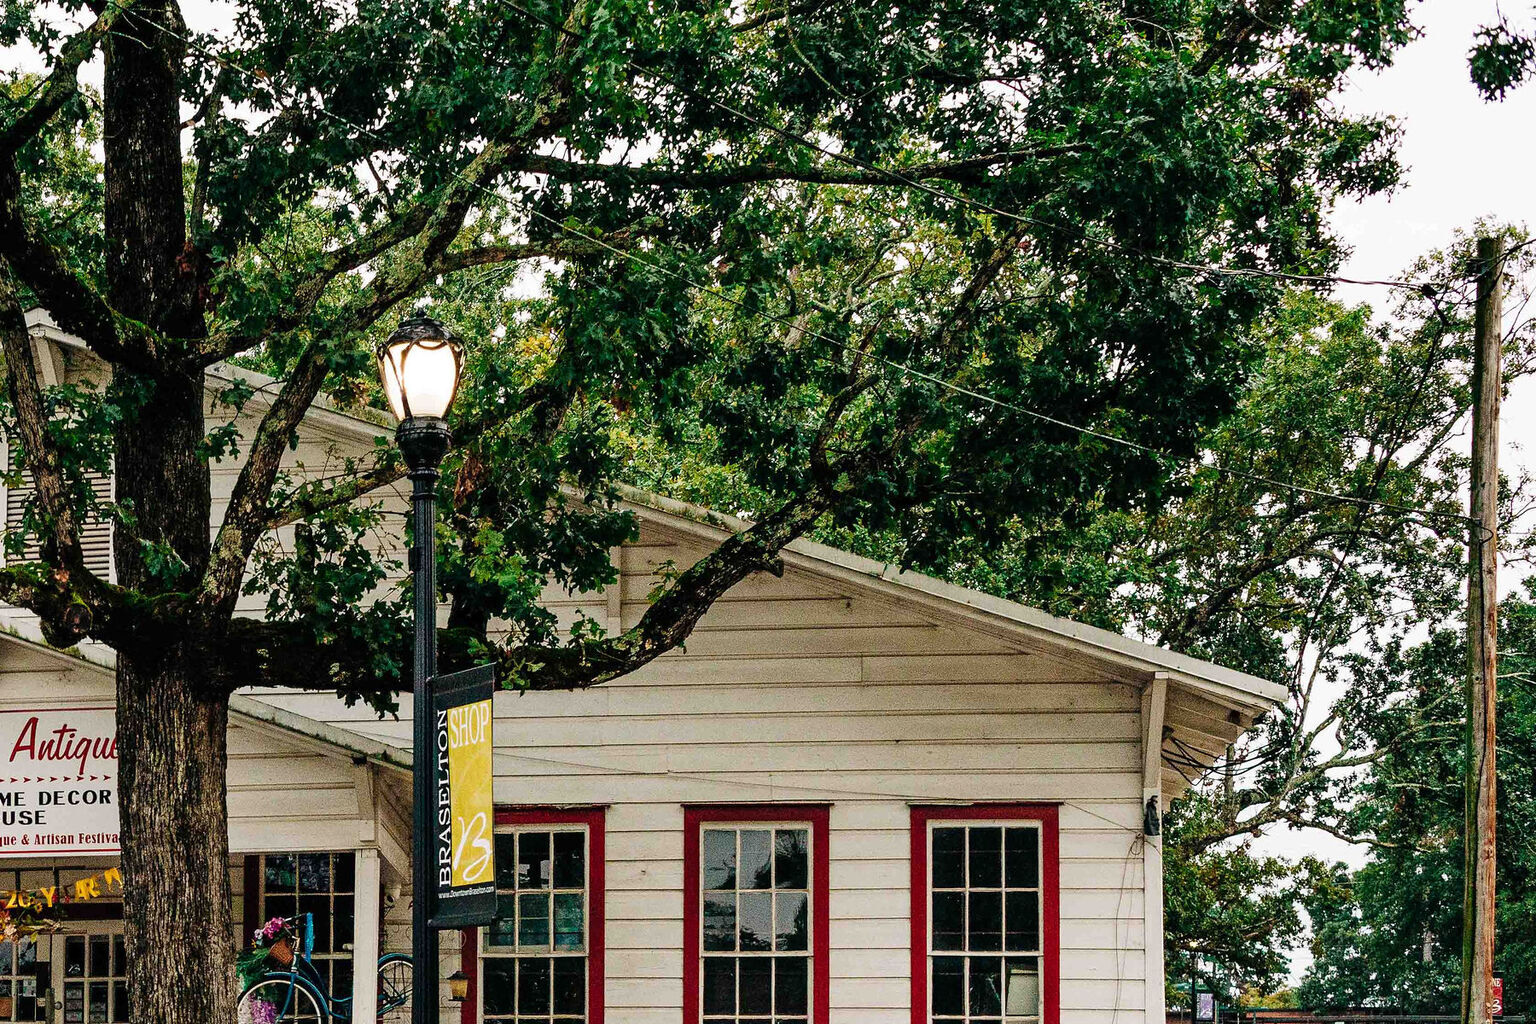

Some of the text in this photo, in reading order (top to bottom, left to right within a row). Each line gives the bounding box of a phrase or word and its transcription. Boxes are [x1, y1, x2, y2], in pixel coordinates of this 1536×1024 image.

[450, 702, 489, 748] SHOP
[38, 790, 112, 806] DECOR
[437, 710, 451, 887] BRASELTON
[21, 834, 30, 845] &
[34, 833, 75, 845] Artisan
